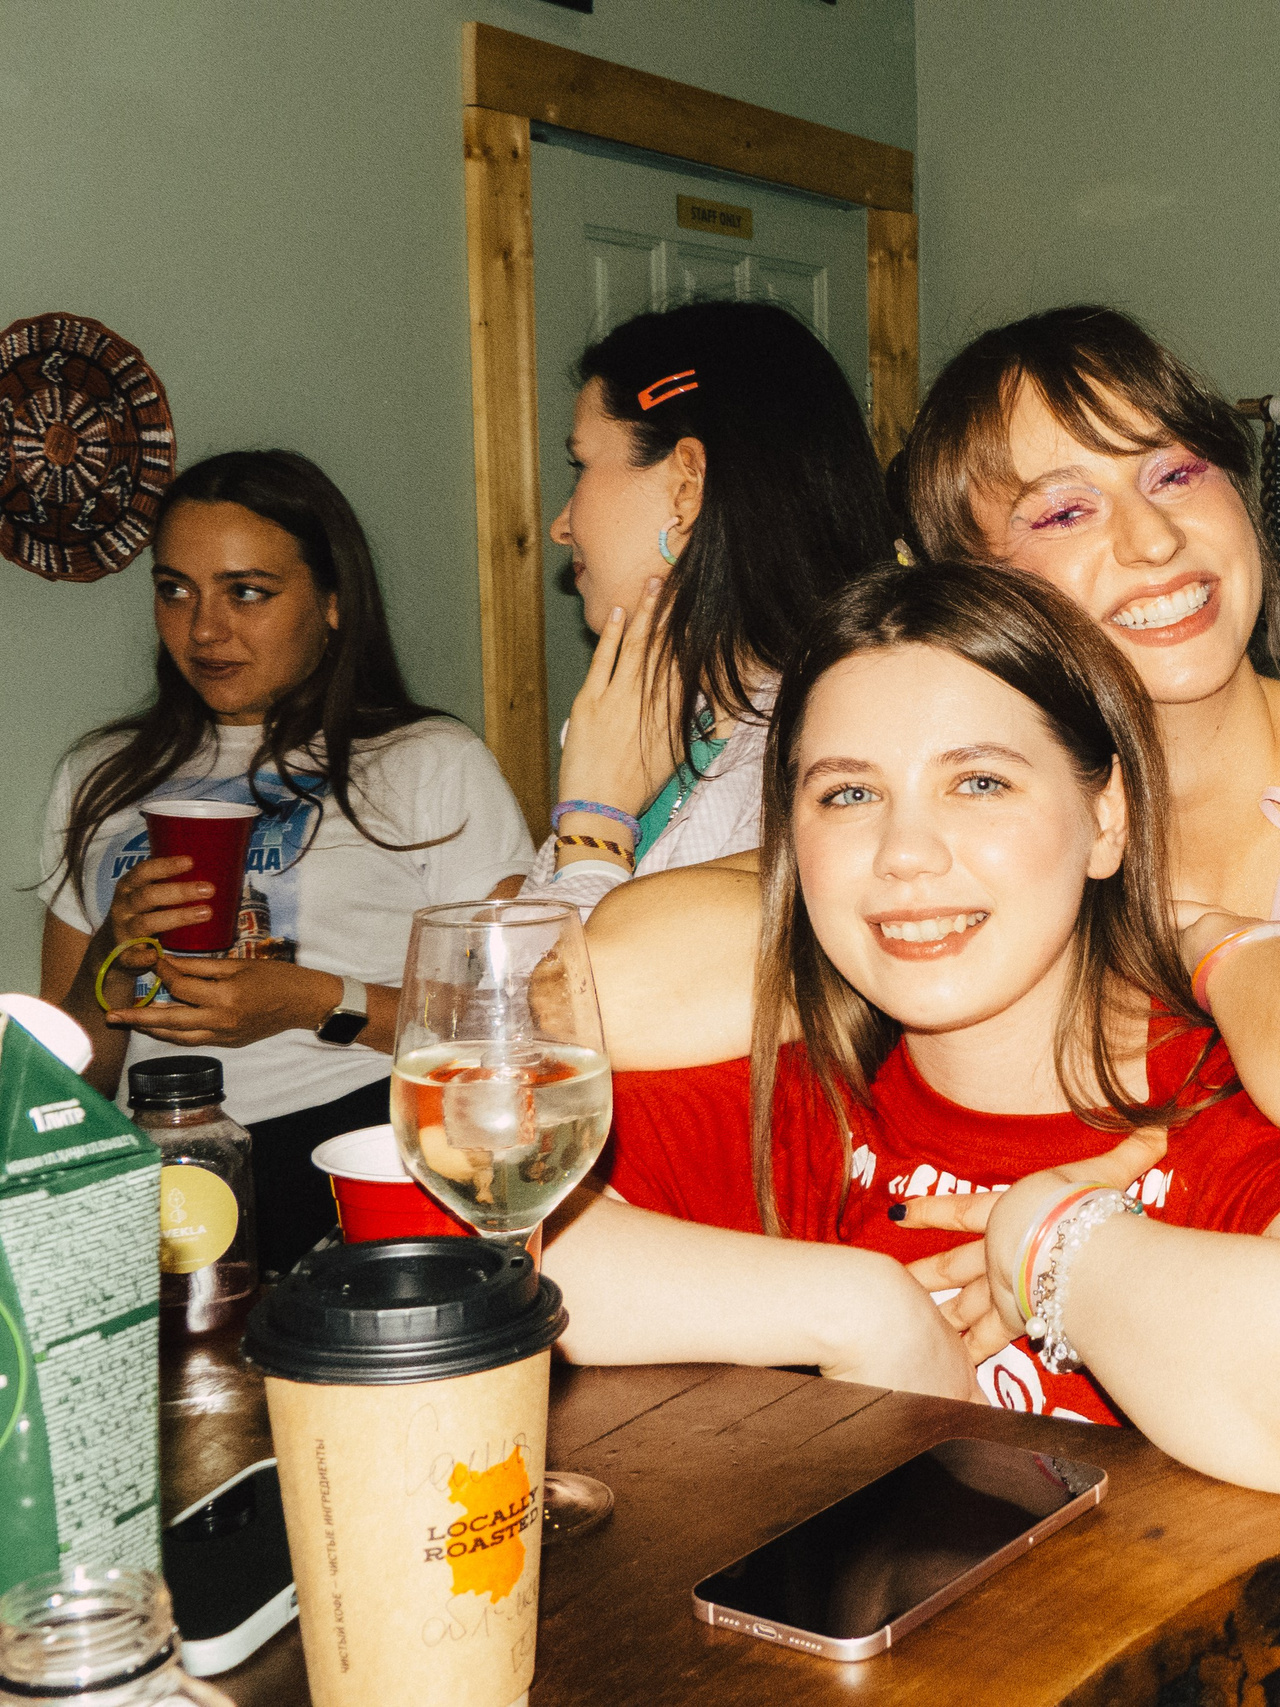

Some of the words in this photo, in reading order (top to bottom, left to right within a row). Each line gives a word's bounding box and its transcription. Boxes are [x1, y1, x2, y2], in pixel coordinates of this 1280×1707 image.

[691, 206, 717, 223] STAFF
[720, 212, 742, 228] ONLY
[161, 1225, 207, 1239] VEKLA
[315, 1438, 334, 1526] ИНГРЕДИЕНТЫ
[423, 1507, 539, 1562] ROASTED
[427, 1487, 539, 1541] LOCALLY
[325, 1530, 339, 1576] ЧИСТЫЕ
[332, 1594, 344, 1623] КОФЕ
[334, 1627, 349, 1674] ЧИСТЫЙ
